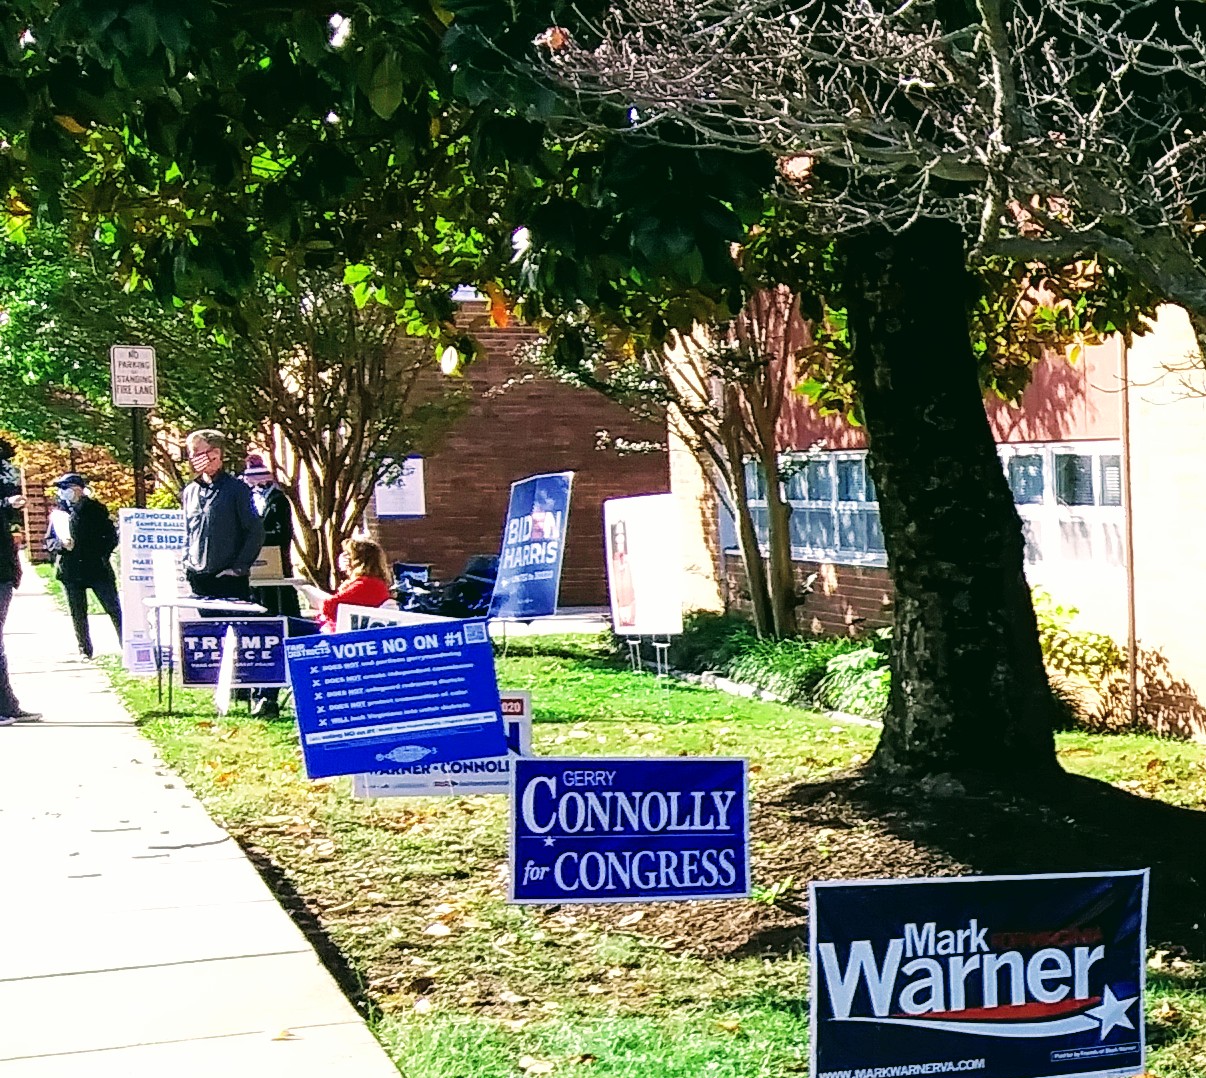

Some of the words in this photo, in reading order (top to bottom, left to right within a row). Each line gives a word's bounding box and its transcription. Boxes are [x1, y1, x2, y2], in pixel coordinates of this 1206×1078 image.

[129, 350, 139, 359] NO
[118, 361, 150, 369] PARKING
[117, 376, 153, 384] STANDING
[117, 385, 132, 394] FIRE
[134, 386, 153, 395] LANE
[134, 512, 184, 520] DEMOCRATI
[506, 510, 562, 545] BIDEN
[132, 534, 154, 543] JOE
[156, 535, 184, 544] BIDE
[502, 541, 558, 570] HARRIS
[184, 636, 280, 650] TRMP
[332, 641, 378, 659] VOTE
[382, 637, 407, 654] NO
[414, 634, 438, 650] ON
[444, 632, 464, 646] #1
[501, 702, 521, 712] 020
[562, 770, 617, 786] GERRY
[521, 776, 736, 834] CONNOLLY
[522, 860, 550, 886] for
[554, 848, 736, 891] CONGRESS
[904, 918, 990, 958] Mark
[818, 938, 1106, 1019] Warner
